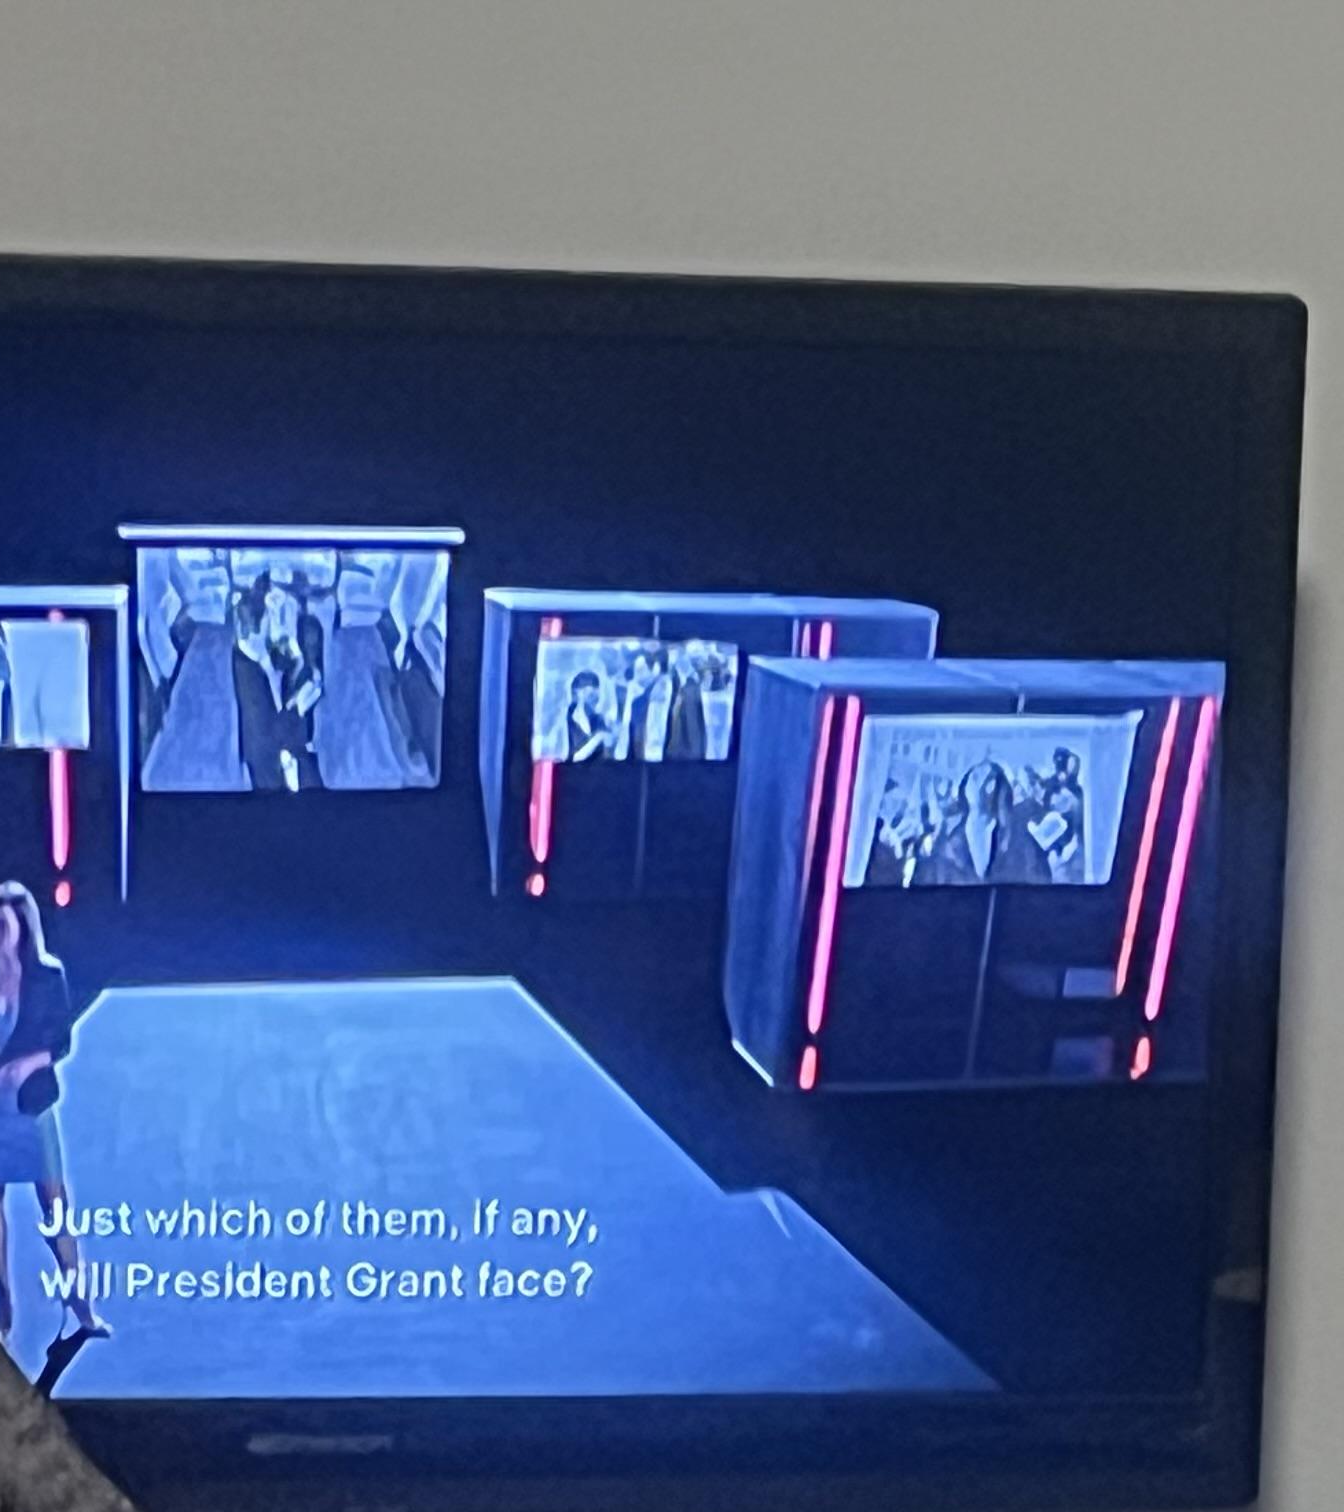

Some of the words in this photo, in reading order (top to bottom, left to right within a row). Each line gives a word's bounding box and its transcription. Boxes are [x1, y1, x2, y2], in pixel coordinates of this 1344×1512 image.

[38, 1197, 132, 1237] Just
[145, 1198, 271, 1238] which
[286, 1199, 326, 1237] of
[342, 1199, 457, 1242] them,
[473, 1197, 500, 1237] if
[511, 1207, 598, 1248] any,
[40, 1260, 112, 1300] will
[126, 1260, 334, 1299] President
[346, 1260, 464, 1299] Grant
[478, 1260, 594, 1299] face?
